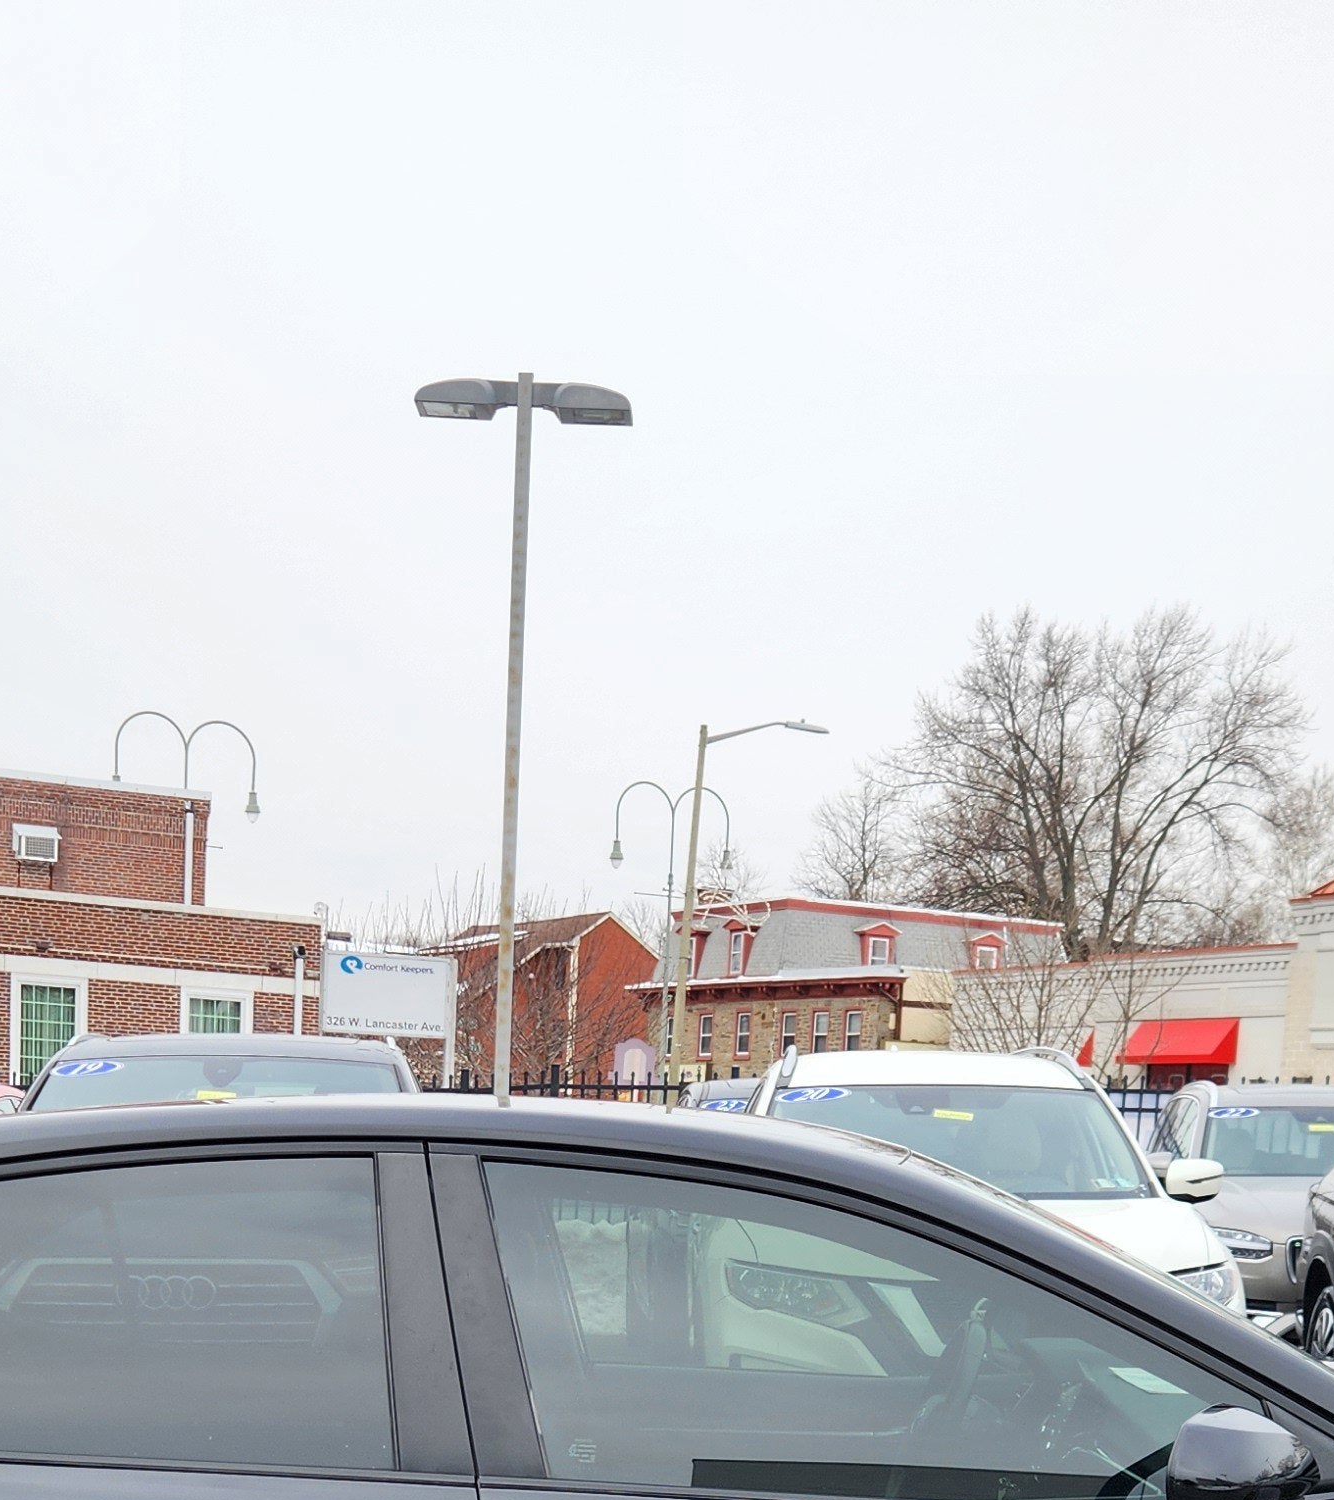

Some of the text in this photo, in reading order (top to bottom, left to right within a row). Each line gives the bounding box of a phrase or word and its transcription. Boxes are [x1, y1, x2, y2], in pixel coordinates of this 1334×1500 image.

[364, 962, 434, 975] Comfort Keepers
[326, 1016, 445, 1033] 326 W. Lancaster Ave.
